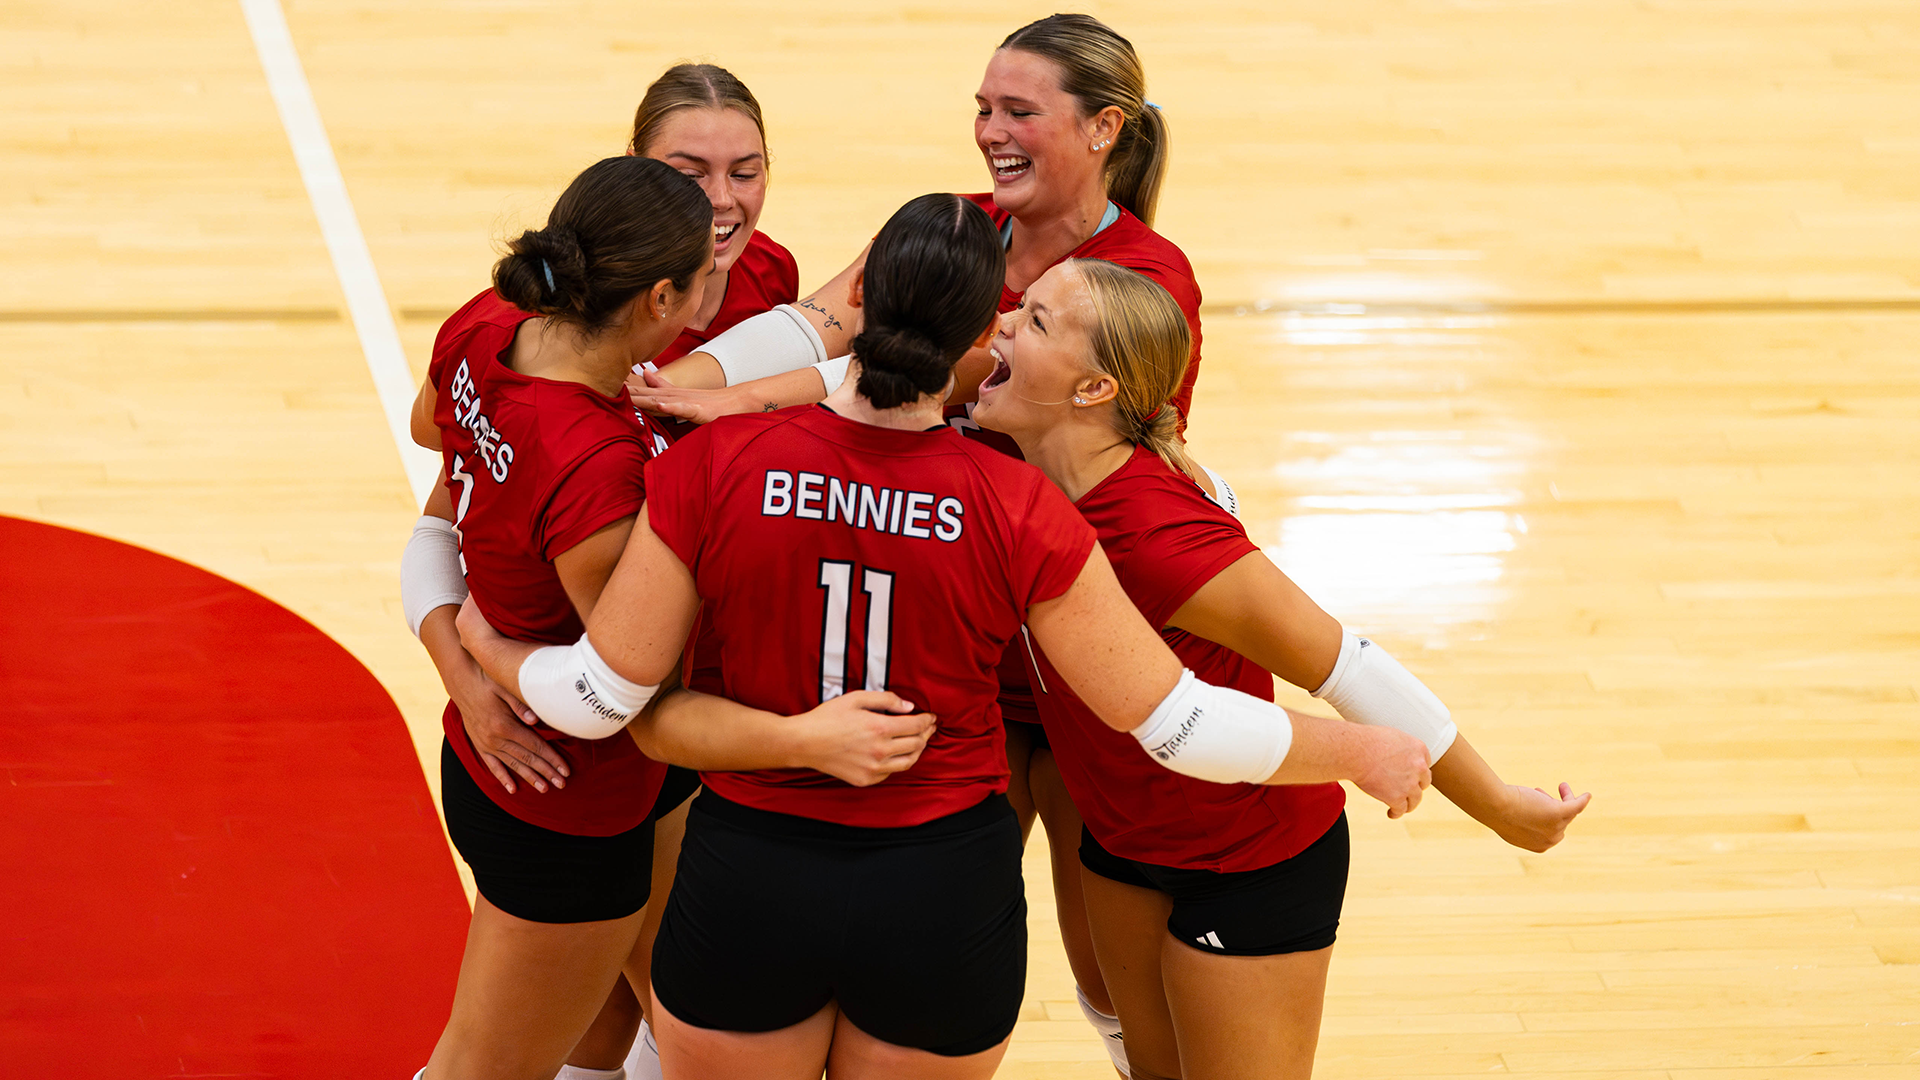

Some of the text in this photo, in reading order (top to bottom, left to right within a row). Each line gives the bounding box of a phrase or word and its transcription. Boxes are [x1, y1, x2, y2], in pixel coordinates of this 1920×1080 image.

[824, 314, 843, 331] you
[761, 469, 965, 543] BENNIES
[817, 557, 896, 703] 11
[581, 672, 628, 724] Tandem
[1150, 706, 1204, 757] Tandem
